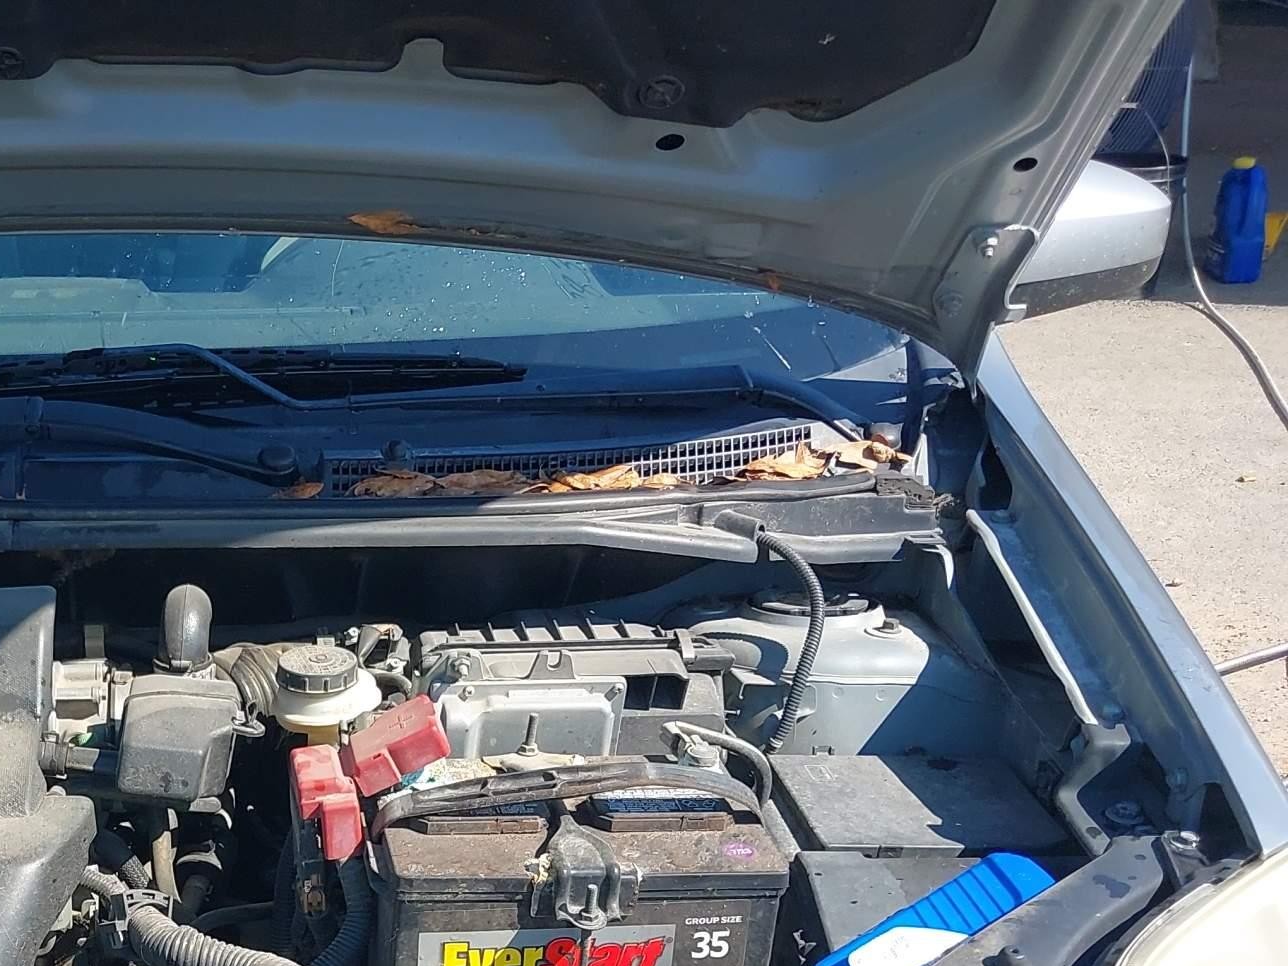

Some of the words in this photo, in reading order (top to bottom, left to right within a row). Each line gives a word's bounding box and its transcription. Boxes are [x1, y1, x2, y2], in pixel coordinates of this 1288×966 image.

[685, 917, 720, 925] GROUP
[721, 915, 743, 923] SIZE
[691, 930, 730, 959] 35
